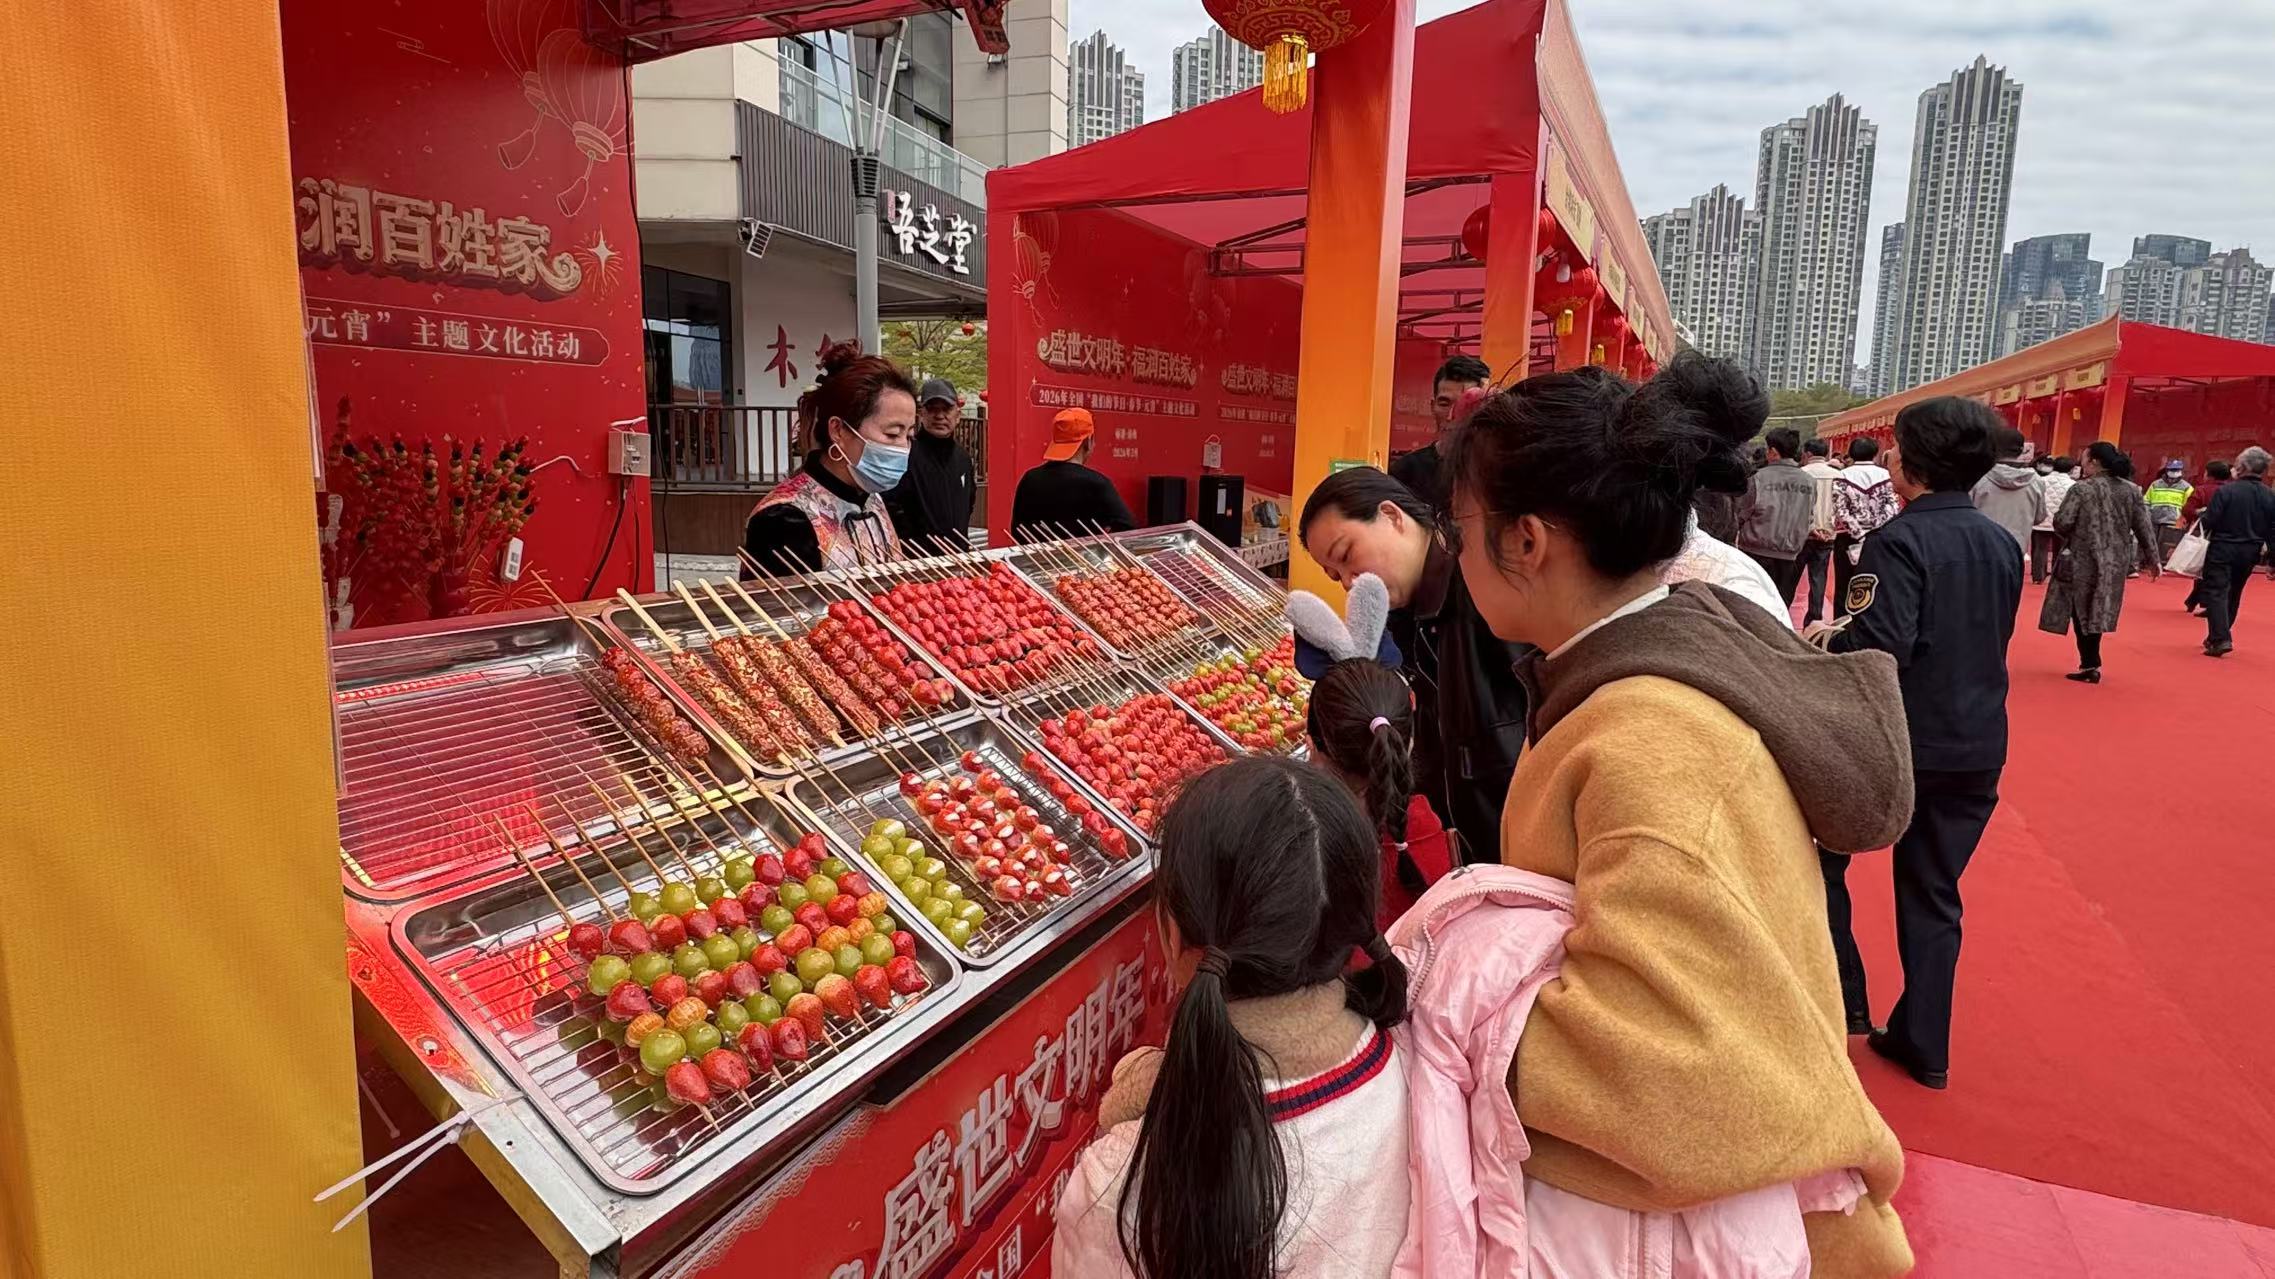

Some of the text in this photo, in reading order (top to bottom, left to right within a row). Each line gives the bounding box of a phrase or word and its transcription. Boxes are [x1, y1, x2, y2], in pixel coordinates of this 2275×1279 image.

[299, 177, 582, 291] 润百姓家
[411, 316, 580, 360] 主题文化活动
